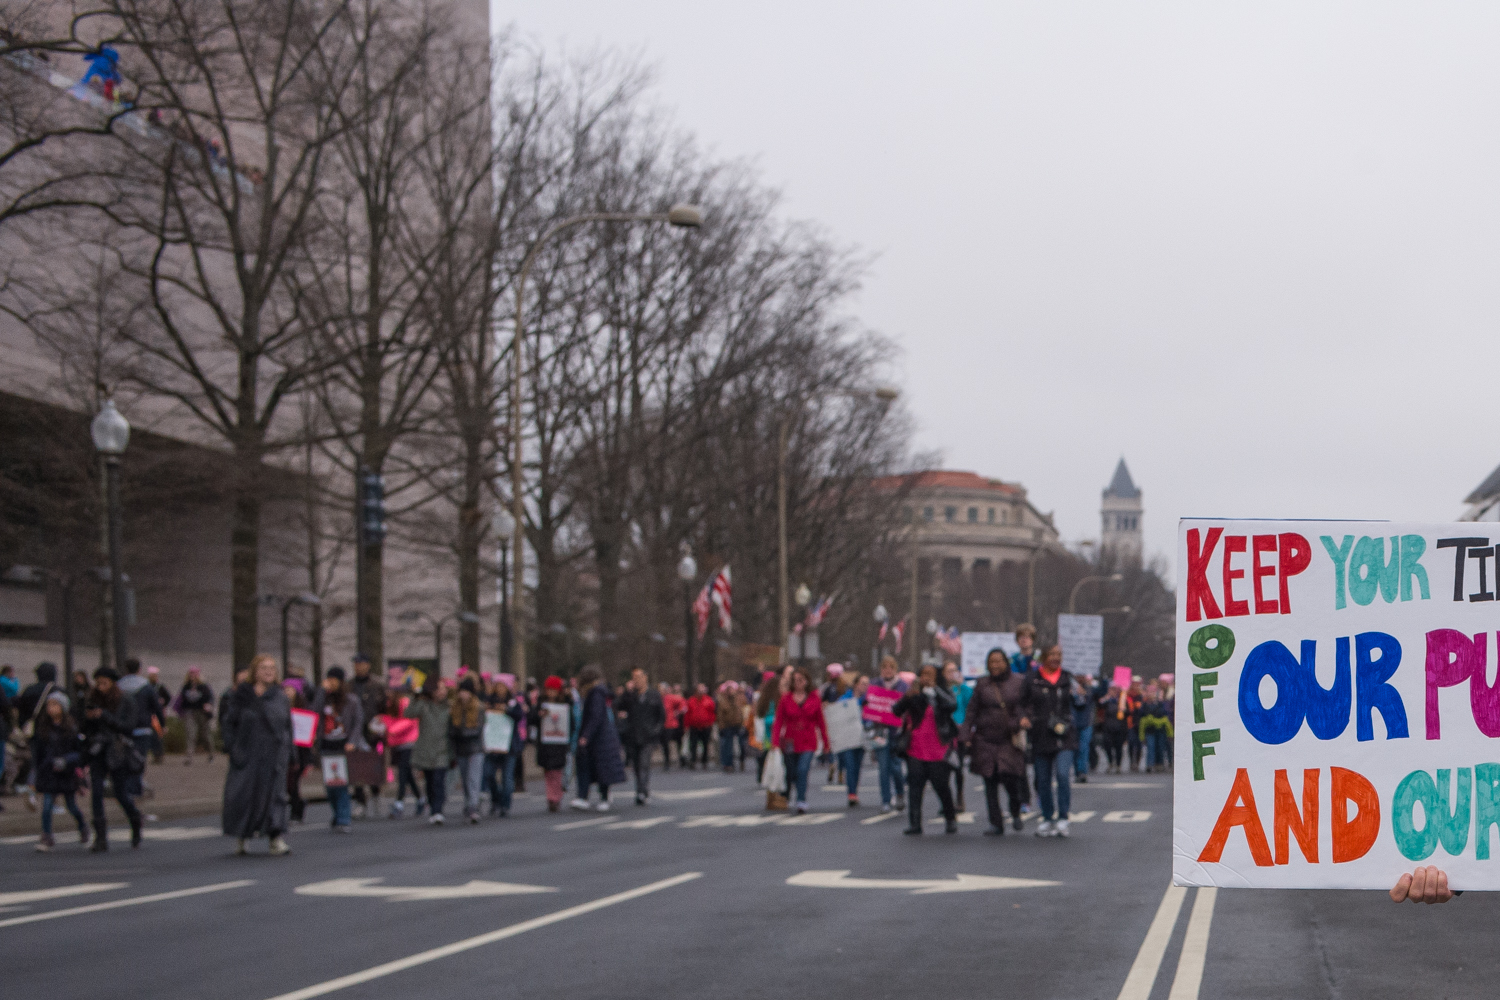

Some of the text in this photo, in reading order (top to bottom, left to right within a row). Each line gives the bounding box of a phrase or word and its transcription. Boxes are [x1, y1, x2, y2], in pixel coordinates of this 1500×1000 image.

[1186, 527, 1311, 622] KEEP
[1320, 534, 1431, 610] YOUR
[1187, 623, 1236, 781] OFF
[1238, 631, 1410, 745] OUR
[1196, 766, 1381, 867] AND
